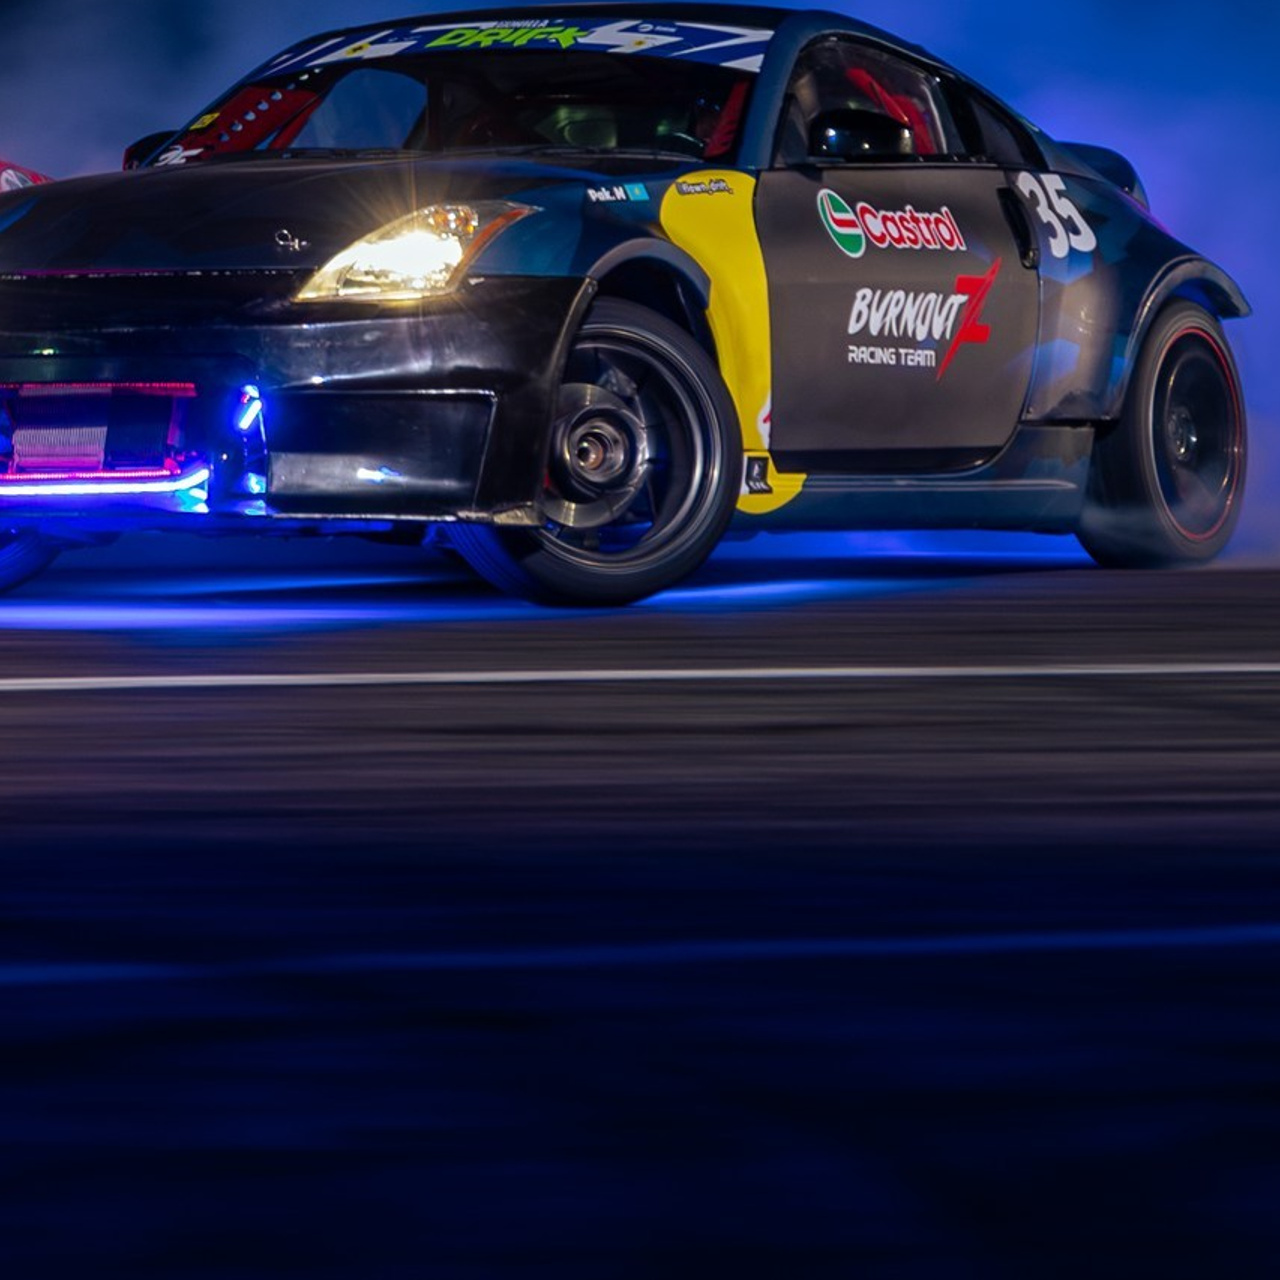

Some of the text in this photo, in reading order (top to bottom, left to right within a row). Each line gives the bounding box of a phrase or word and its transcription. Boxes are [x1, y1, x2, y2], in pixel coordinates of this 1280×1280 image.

[855, 201, 967, 251] Castrol
[1016, 171, 1097, 258] 35
[848, 345, 936, 367] RACING TEAM
